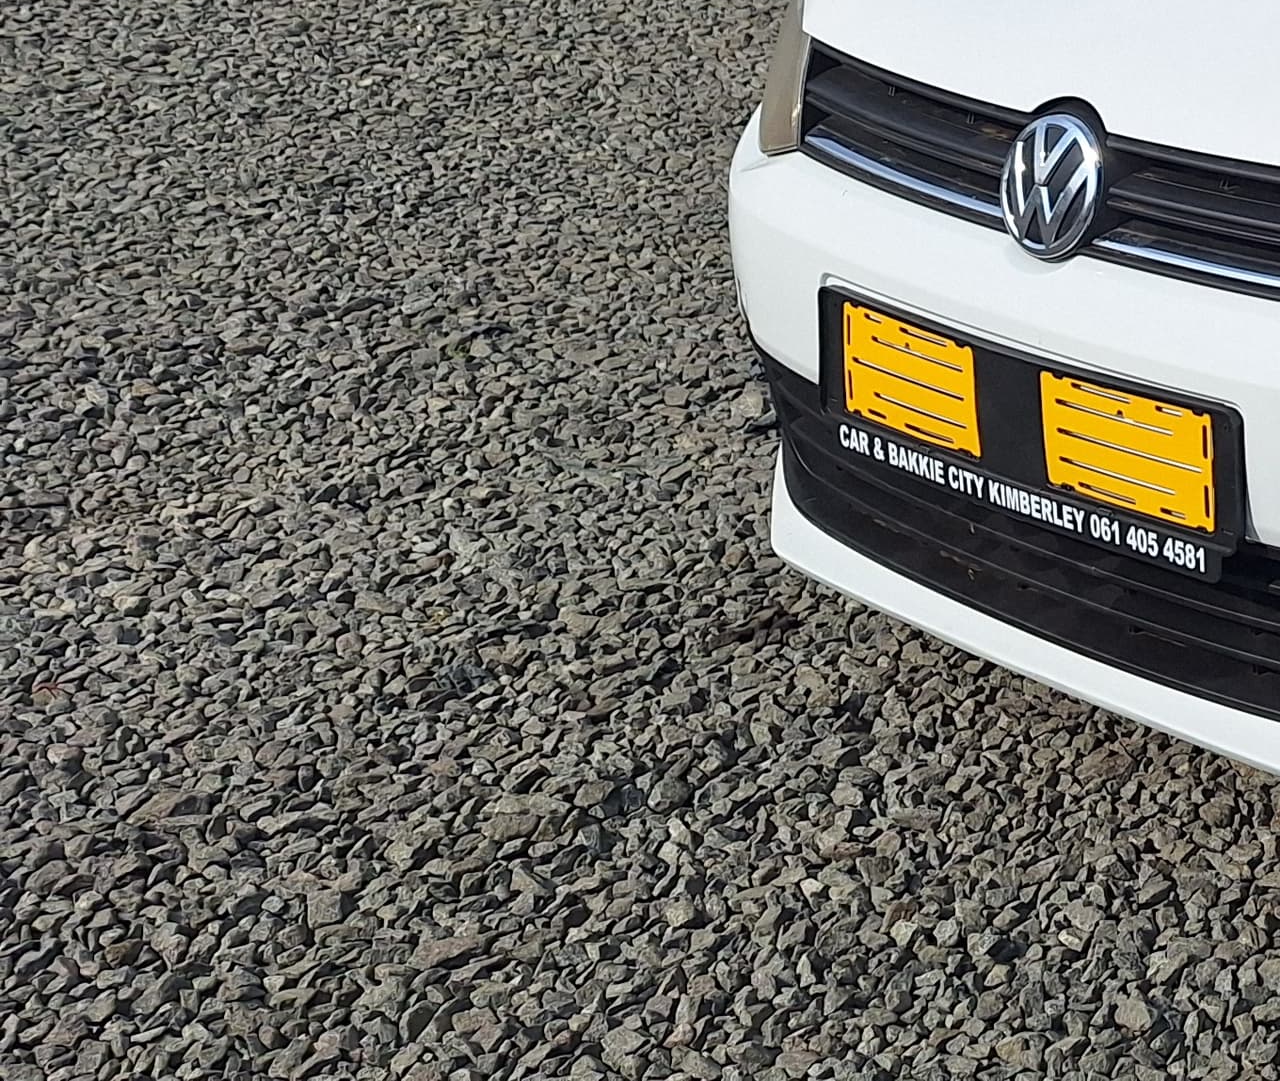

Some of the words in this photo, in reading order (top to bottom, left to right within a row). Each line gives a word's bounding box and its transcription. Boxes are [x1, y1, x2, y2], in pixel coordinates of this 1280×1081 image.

[839, 424, 870, 456] CAR
[873, 437, 885, 461] &
[888, 442, 945, 485] BAKKIE
[948, 465, 984, 499] CITY
[988, 479, 1085, 533] KIMBERLEY
[1090, 513, 1120, 545] 061
[1126, 526, 1159, 557] 405
[1163, 537, 1206, 573] 4581
